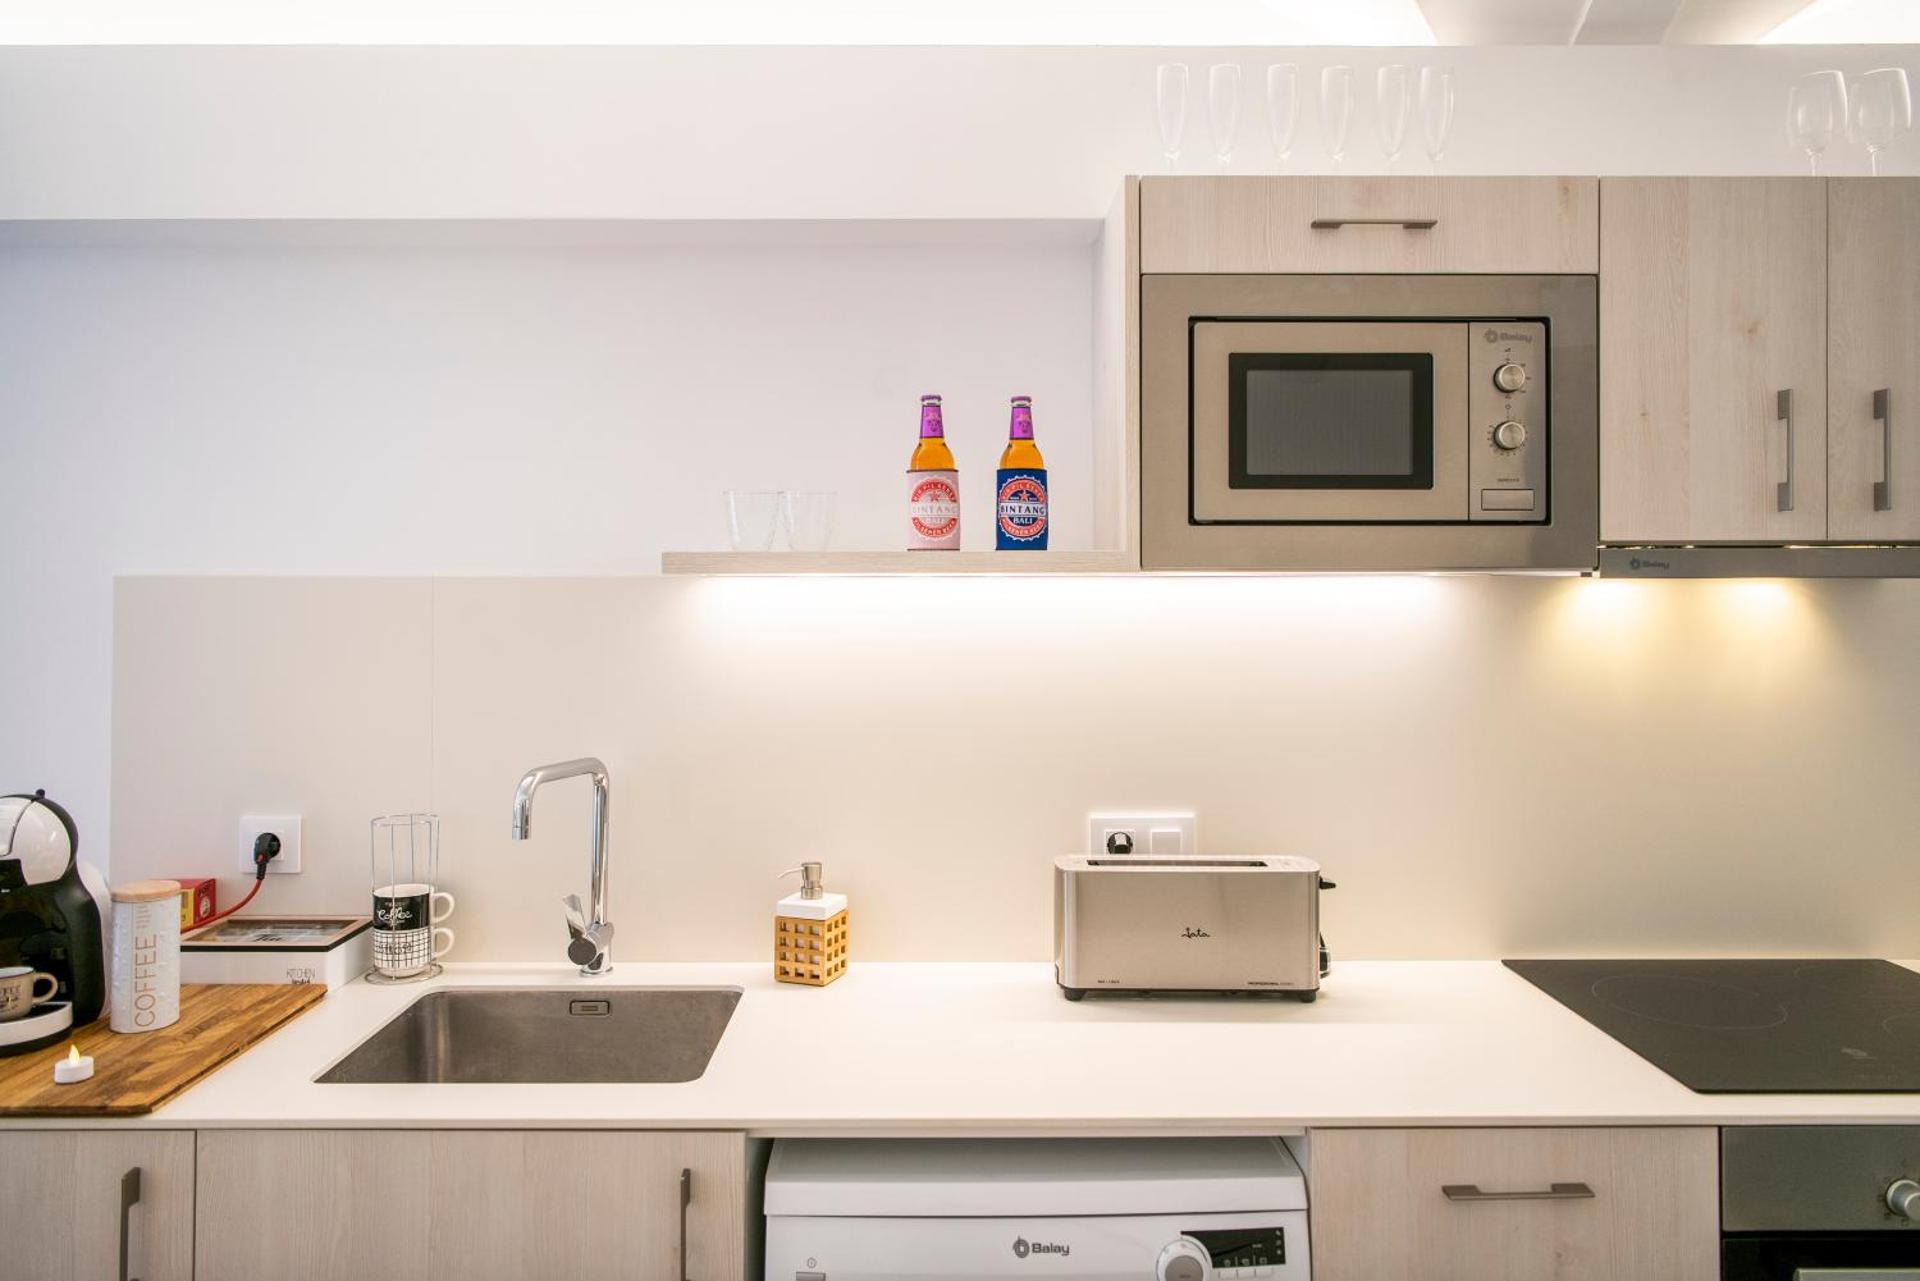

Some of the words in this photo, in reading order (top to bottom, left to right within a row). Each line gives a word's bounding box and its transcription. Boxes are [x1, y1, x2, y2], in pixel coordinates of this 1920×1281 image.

[911, 505, 959, 515] BINTANG
[1000, 505, 1046, 515] BINTANG
[134, 934, 157, 1027] COFFEE
[1031, 1242, 1070, 1256] Balay
